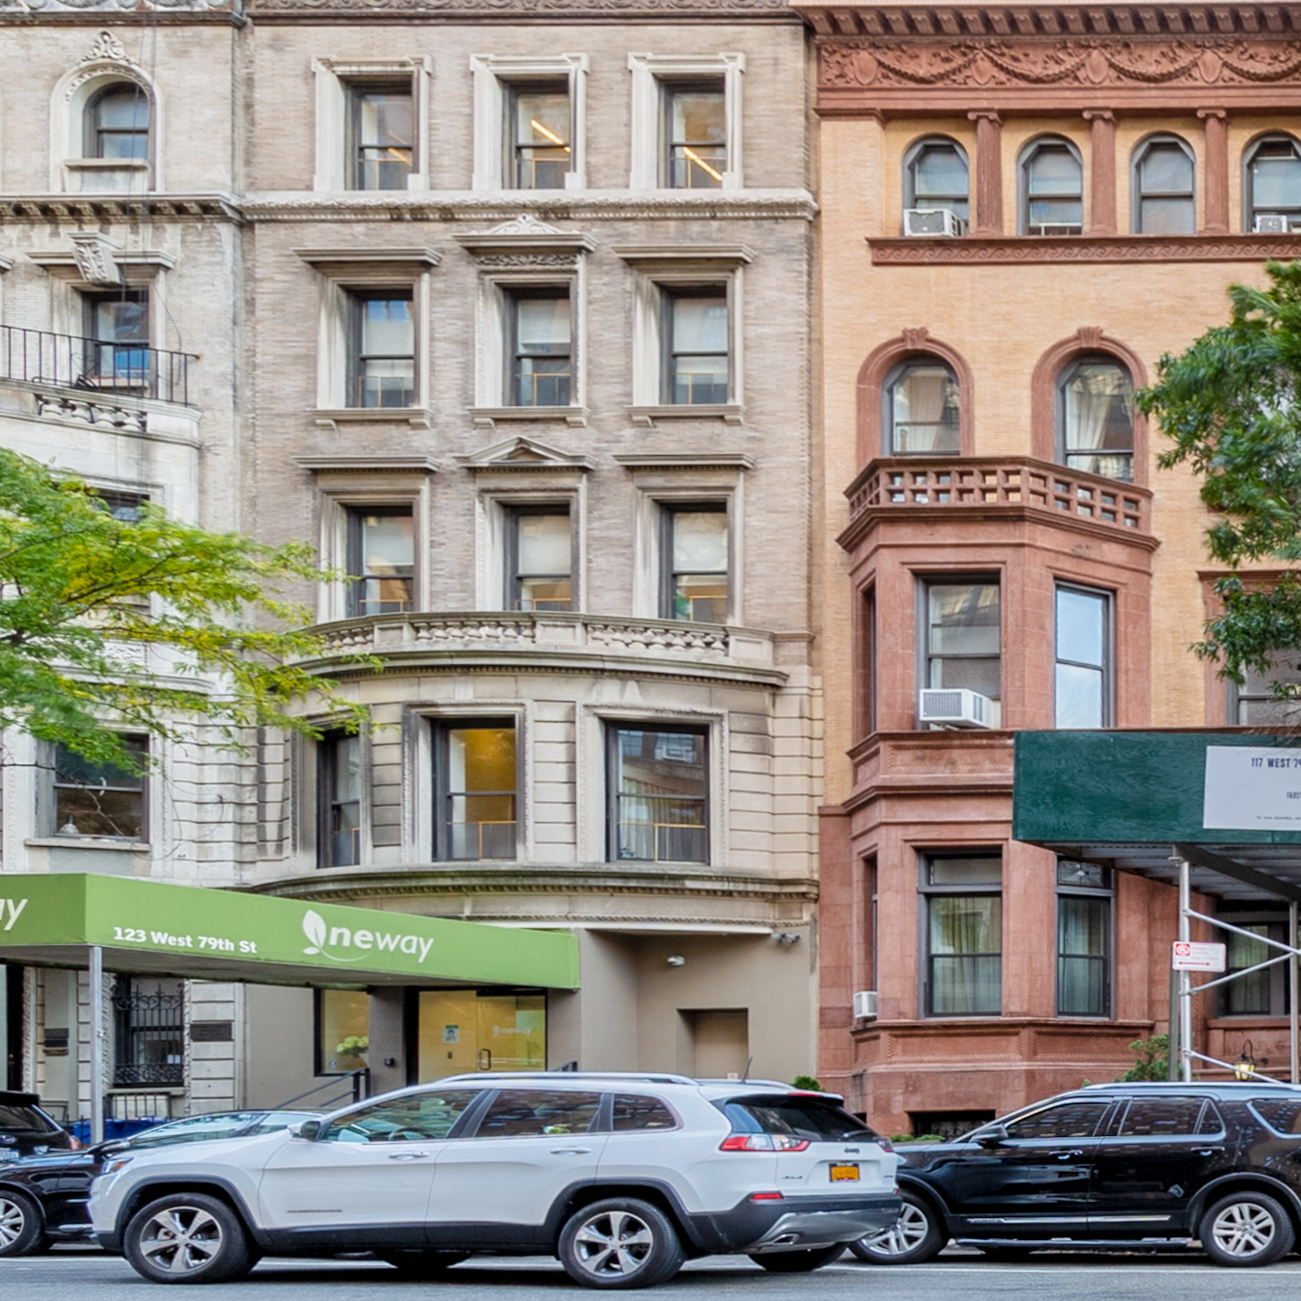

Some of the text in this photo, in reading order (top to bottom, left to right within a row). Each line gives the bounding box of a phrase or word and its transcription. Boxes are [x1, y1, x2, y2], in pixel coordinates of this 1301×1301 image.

[1251, 757, 1263, 768] 117
[1267, 758, 1291, 769] WEST
[113, 926, 258, 954] 123 West 79th St
